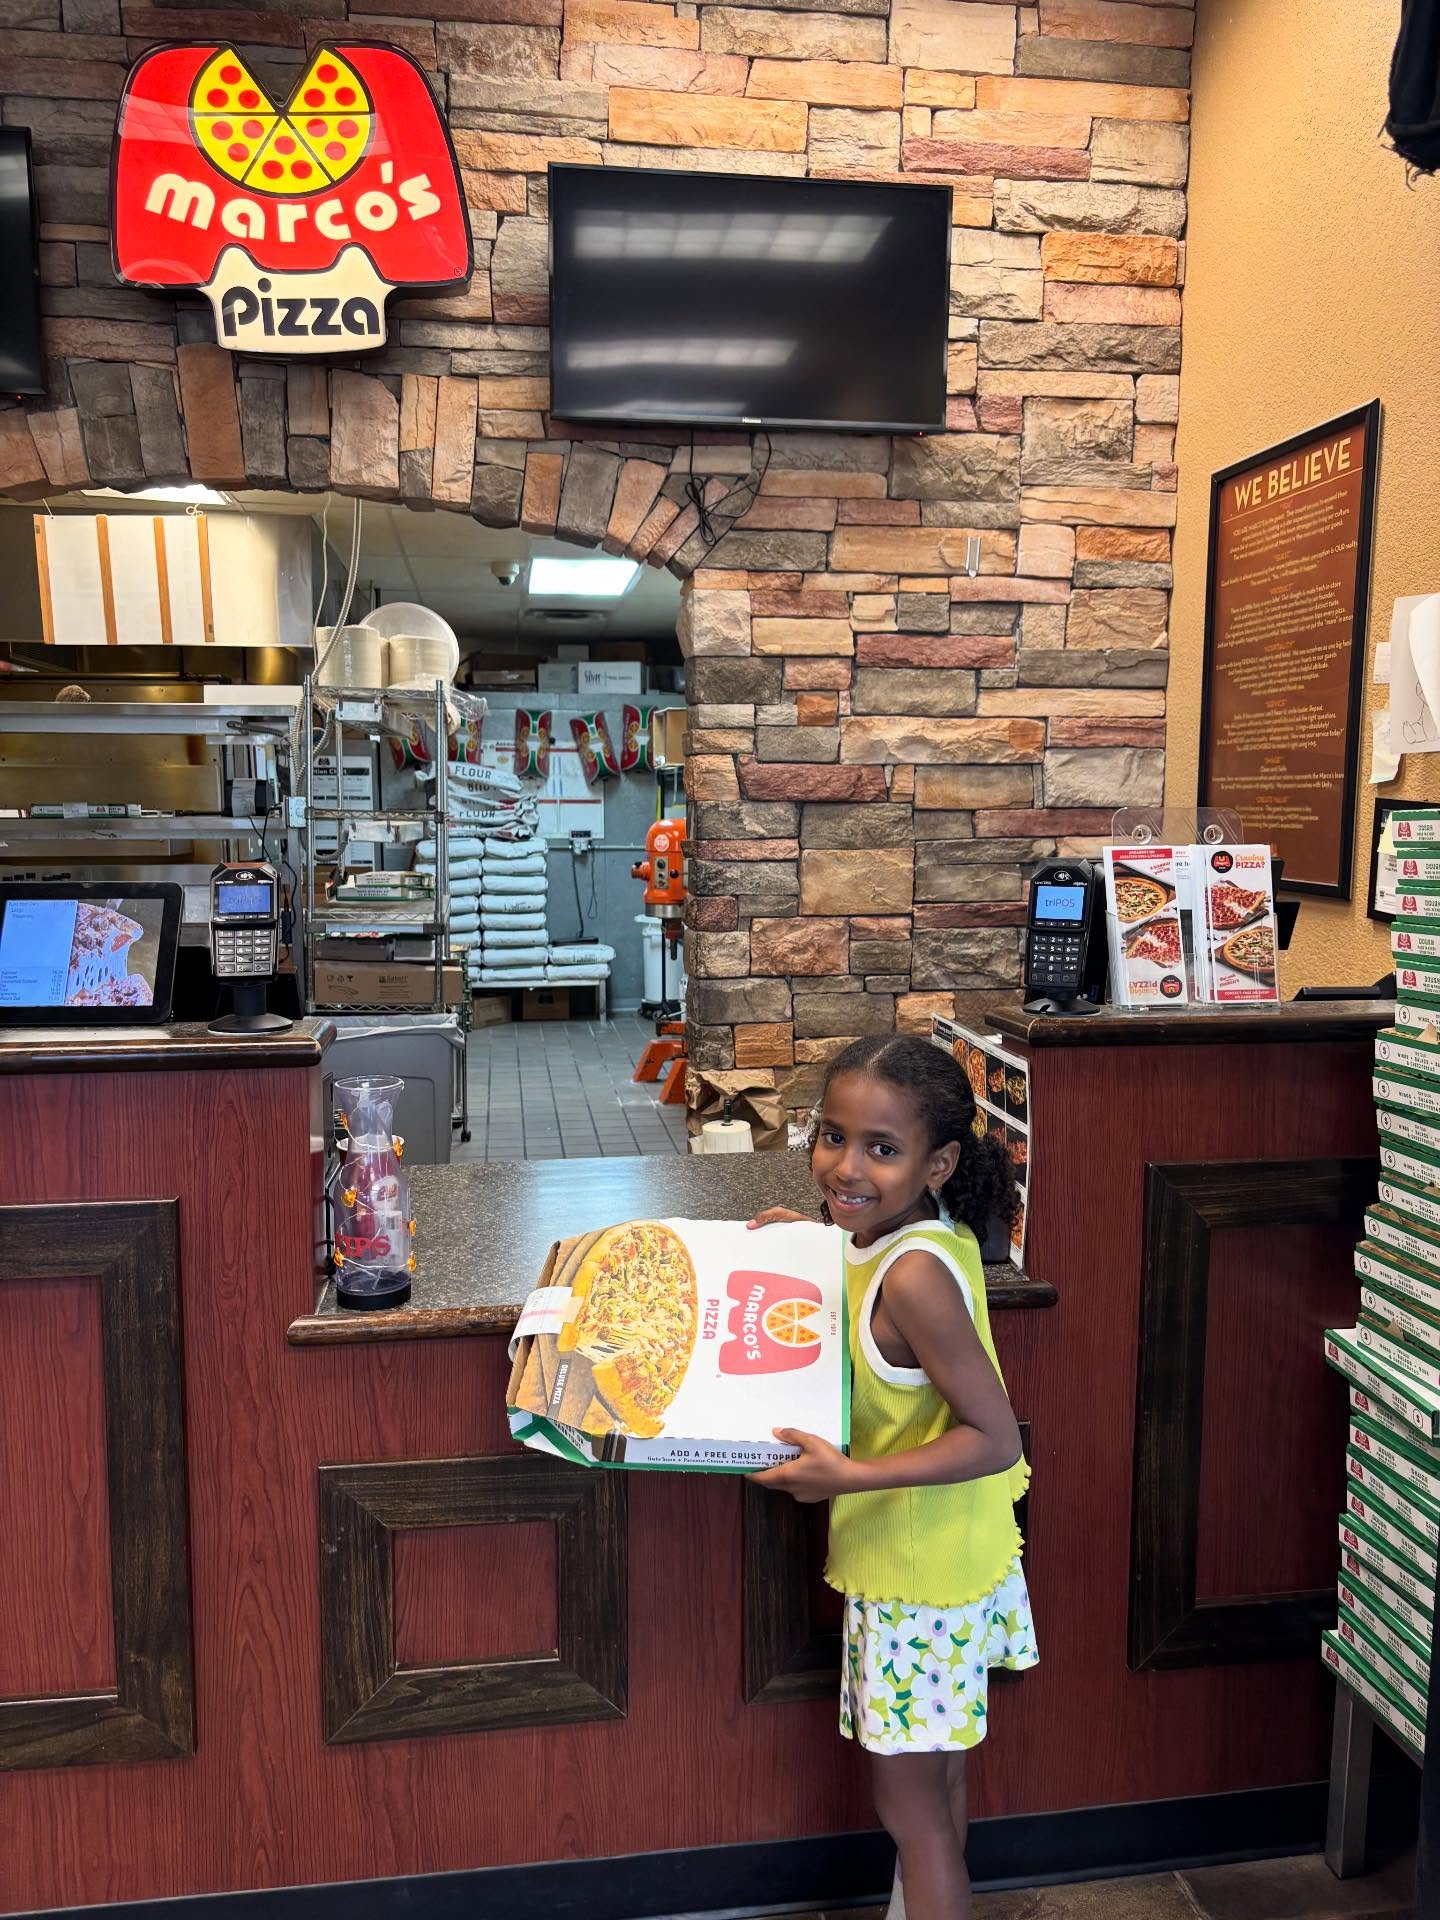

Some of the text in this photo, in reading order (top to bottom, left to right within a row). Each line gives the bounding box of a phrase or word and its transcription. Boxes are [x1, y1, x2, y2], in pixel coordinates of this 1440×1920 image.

[145, 160, 441, 242] marco's
[221, 277, 380, 336] Pizza
[1235, 437, 1352, 512] WE BELIEVE
[455, 765, 492, 779] FLOUR
[1045, 898, 1075, 908] triPOS
[702, 1298, 720, 1340] PIZZA
[743, 1284, 766, 1361] MARCO'S
[552, 1364, 569, 1405] DELUXE PIZZA
[670, 1449, 690, 1457] ADD
[704, 1451, 727, 1459] FREE
[731, 1452, 762, 1460] CRUST
